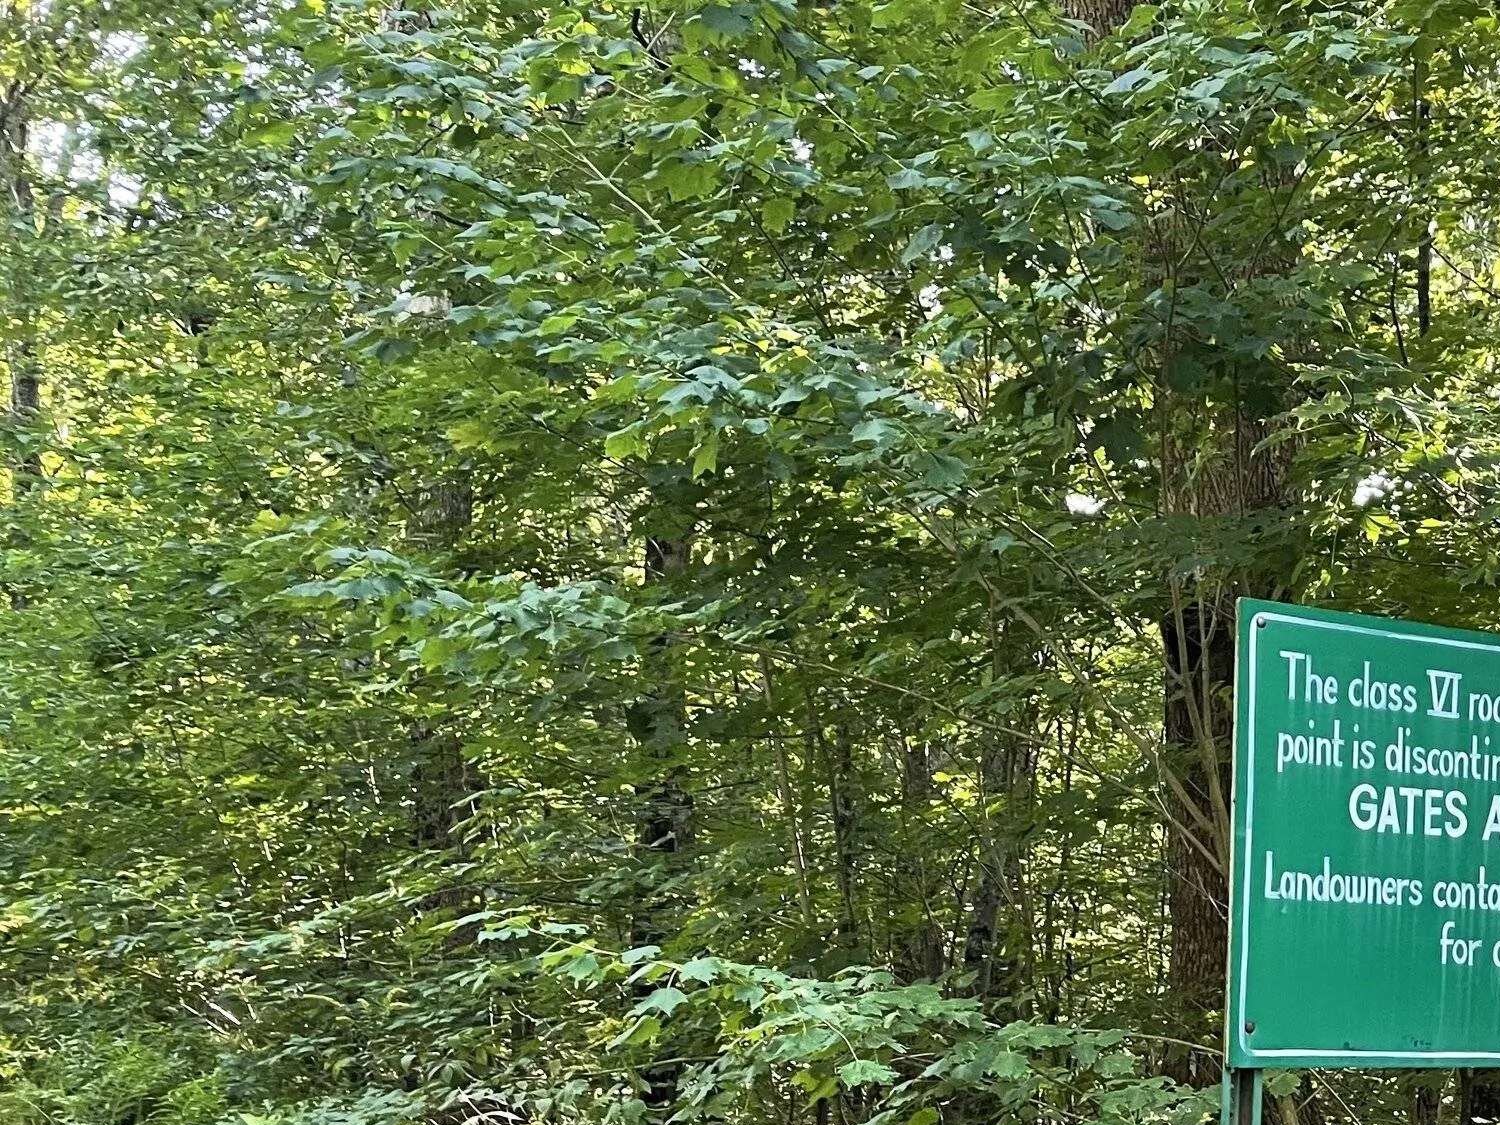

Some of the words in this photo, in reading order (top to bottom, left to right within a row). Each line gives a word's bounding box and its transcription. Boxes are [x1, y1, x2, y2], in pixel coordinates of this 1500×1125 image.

[1279, 650, 1339, 704] The
[1348, 660, 1418, 713] class
[1426, 669, 1463, 719] VI
[1277, 719, 1345, 773] point
[1352, 723, 1377, 769] is
[1348, 783, 1468, 839] GATES
[1264, 851, 1423, 906] Landowners
[1440, 920, 1483, 966] for
